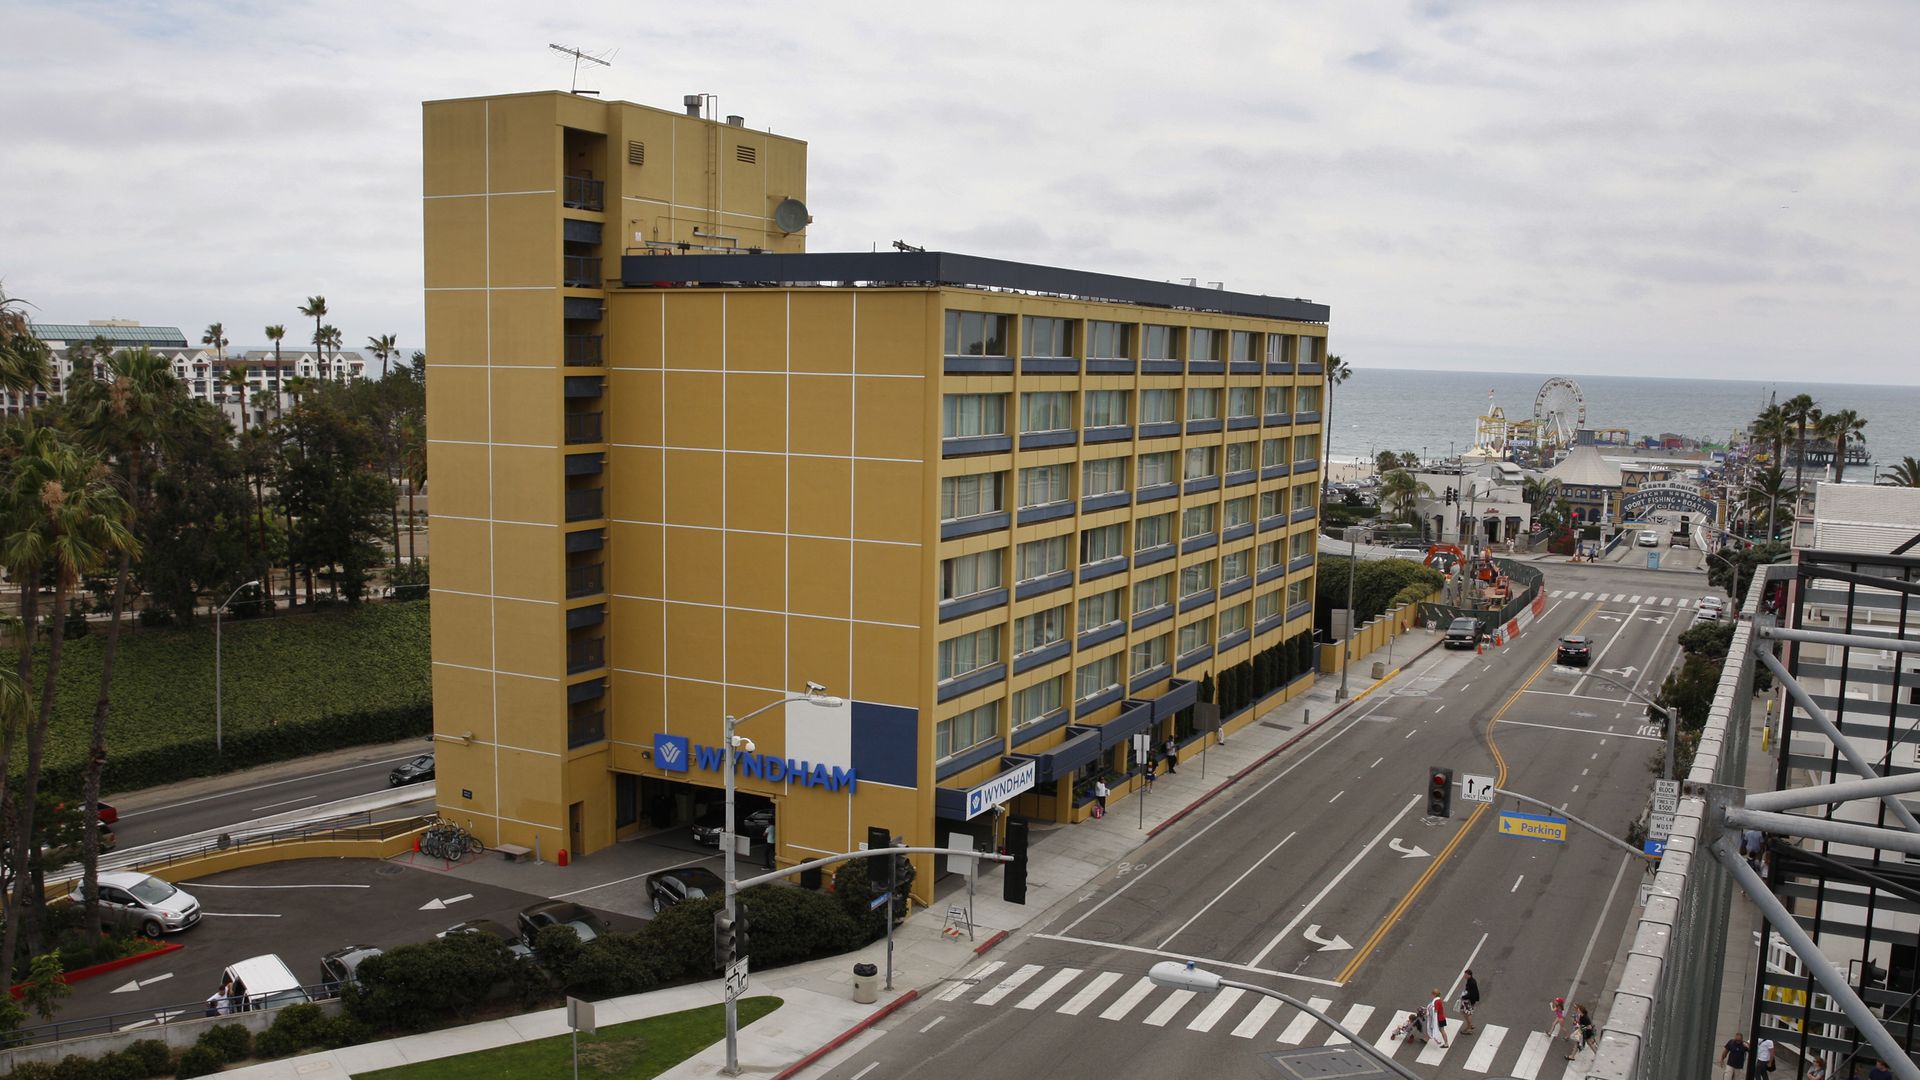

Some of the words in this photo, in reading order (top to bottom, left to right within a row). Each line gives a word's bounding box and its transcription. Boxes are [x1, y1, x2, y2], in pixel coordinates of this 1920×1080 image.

[1638, 490, 1664, 499] YACHT
[1668, 490, 1702, 502] HARBOR
[1624, 499, 1645, 512] SPORT
[1647, 496, 1676, 504] FISHING
[1682, 499, 1712, 516] BOATING
[984, 767, 1033, 804] WYNDHAM
[1521, 822, 1562, 839] Parking
